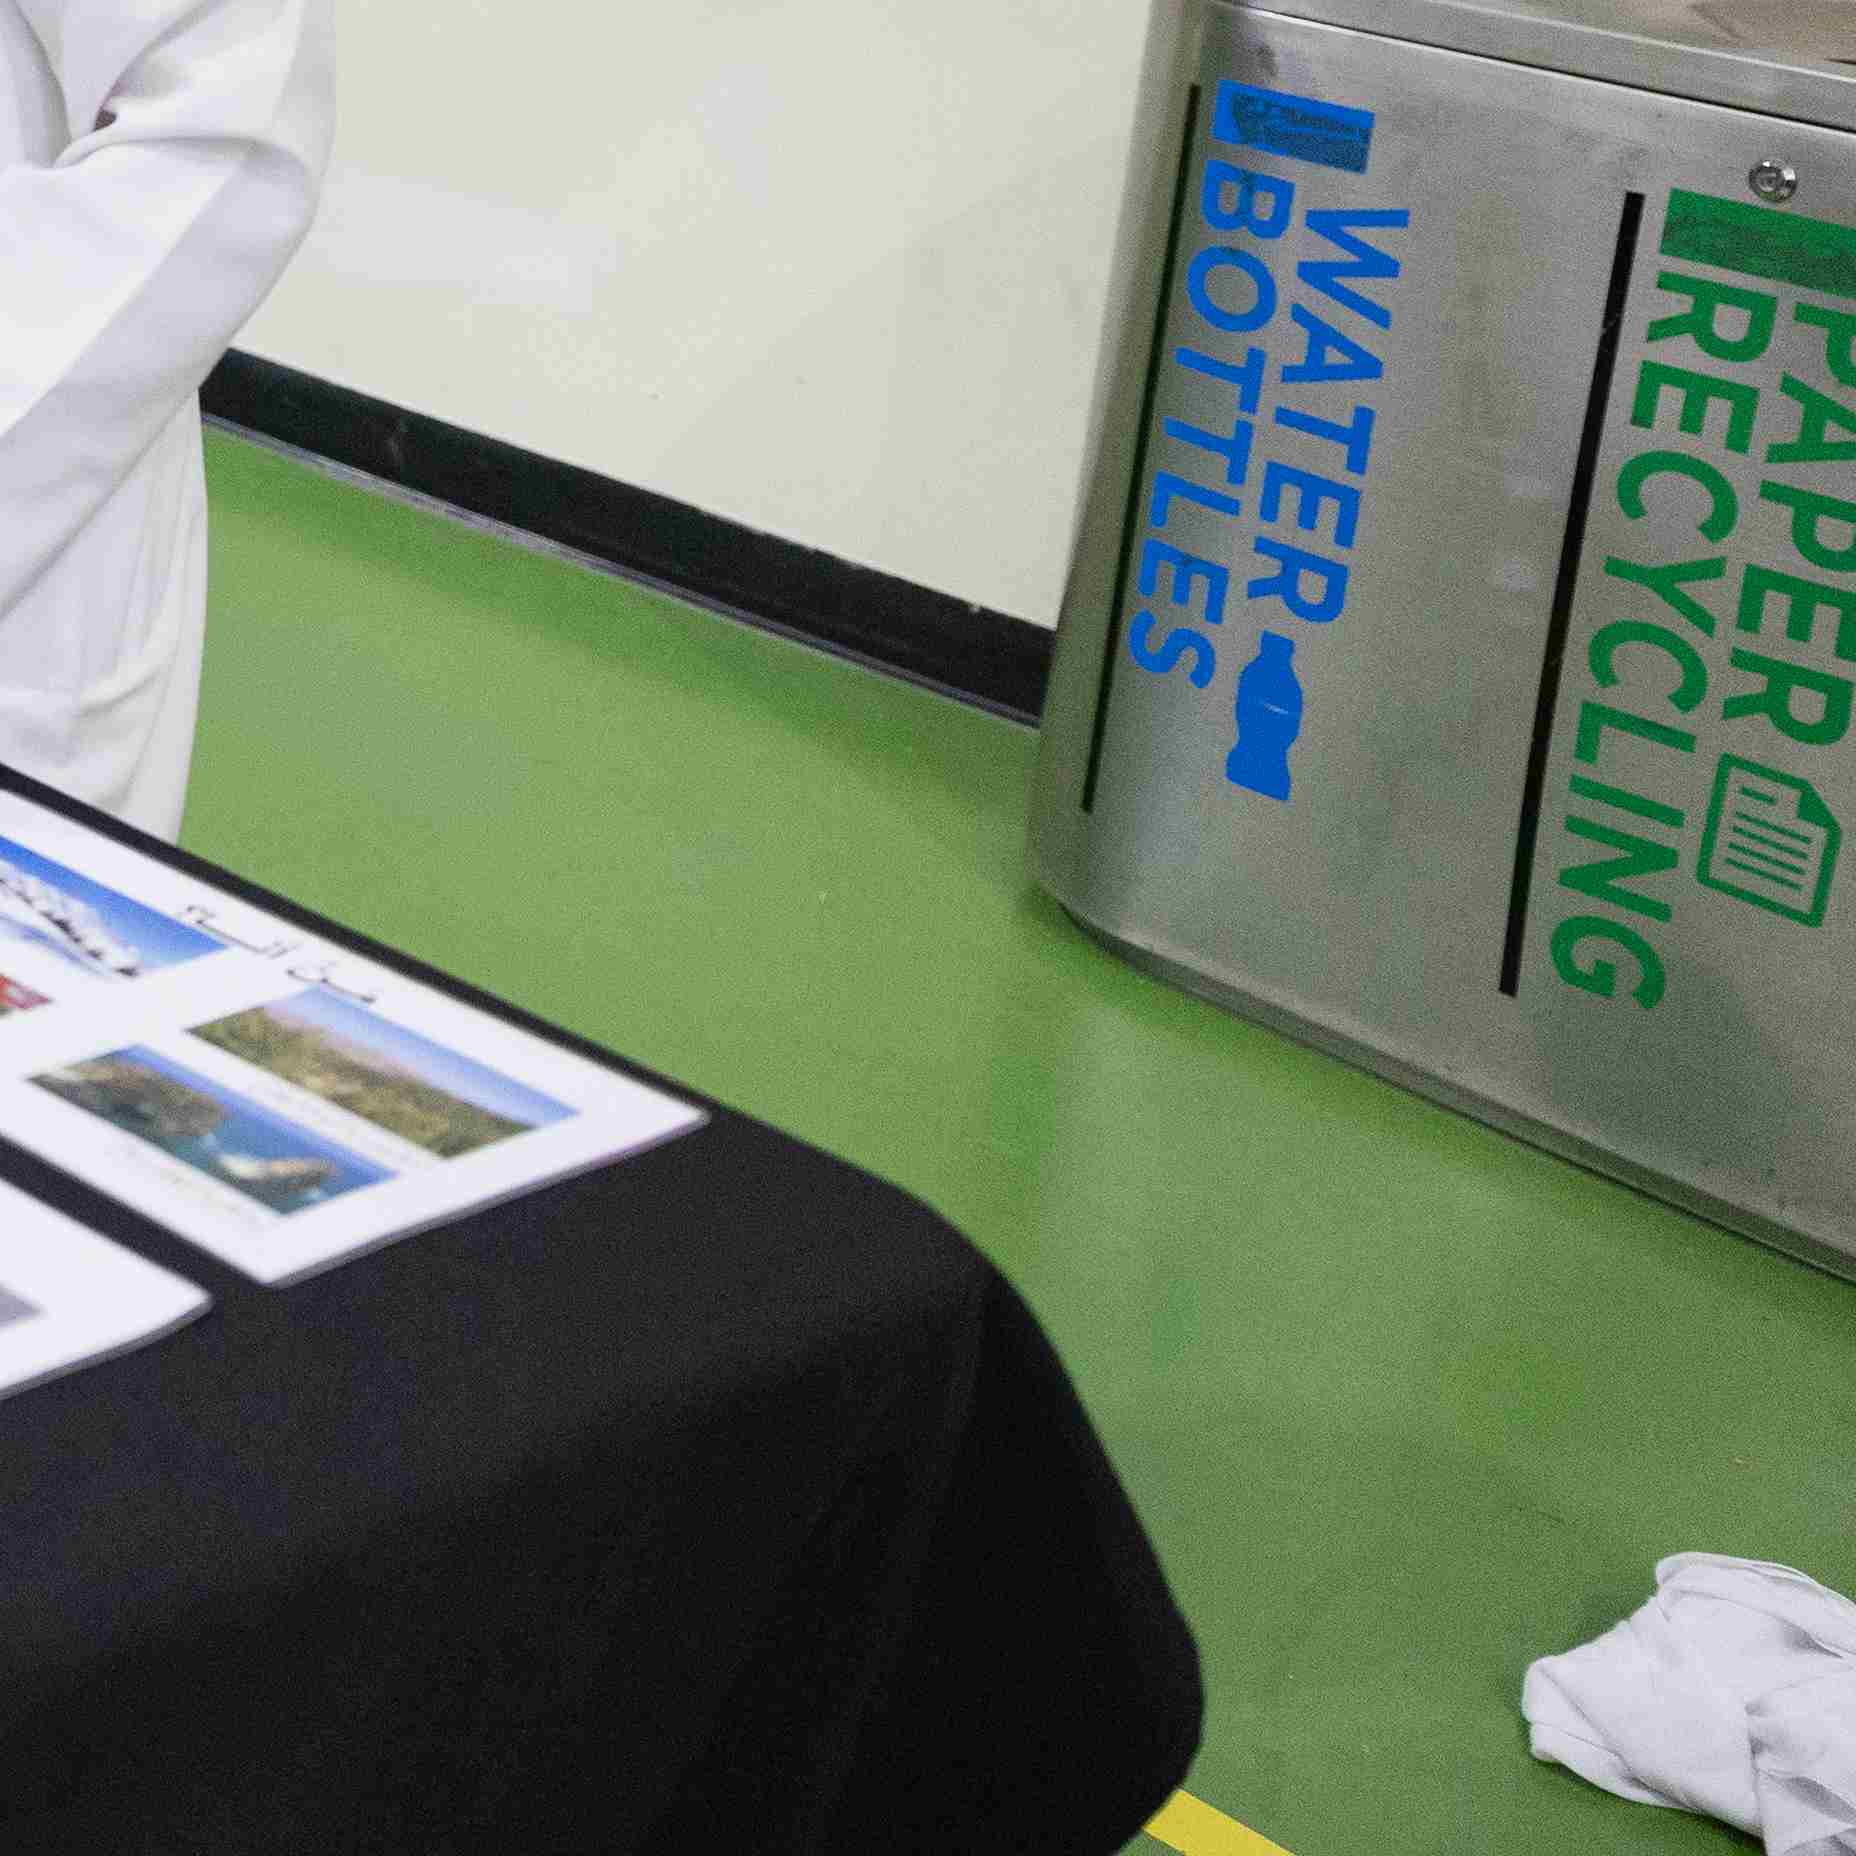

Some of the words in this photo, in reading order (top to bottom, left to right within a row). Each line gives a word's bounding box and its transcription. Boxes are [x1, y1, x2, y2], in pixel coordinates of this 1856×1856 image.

[1127, 159, 1296, 691] BOTTLES
[1246, 207, 1410, 626] WATER
[1551, 270, 1778, 1010] RECYCLING
